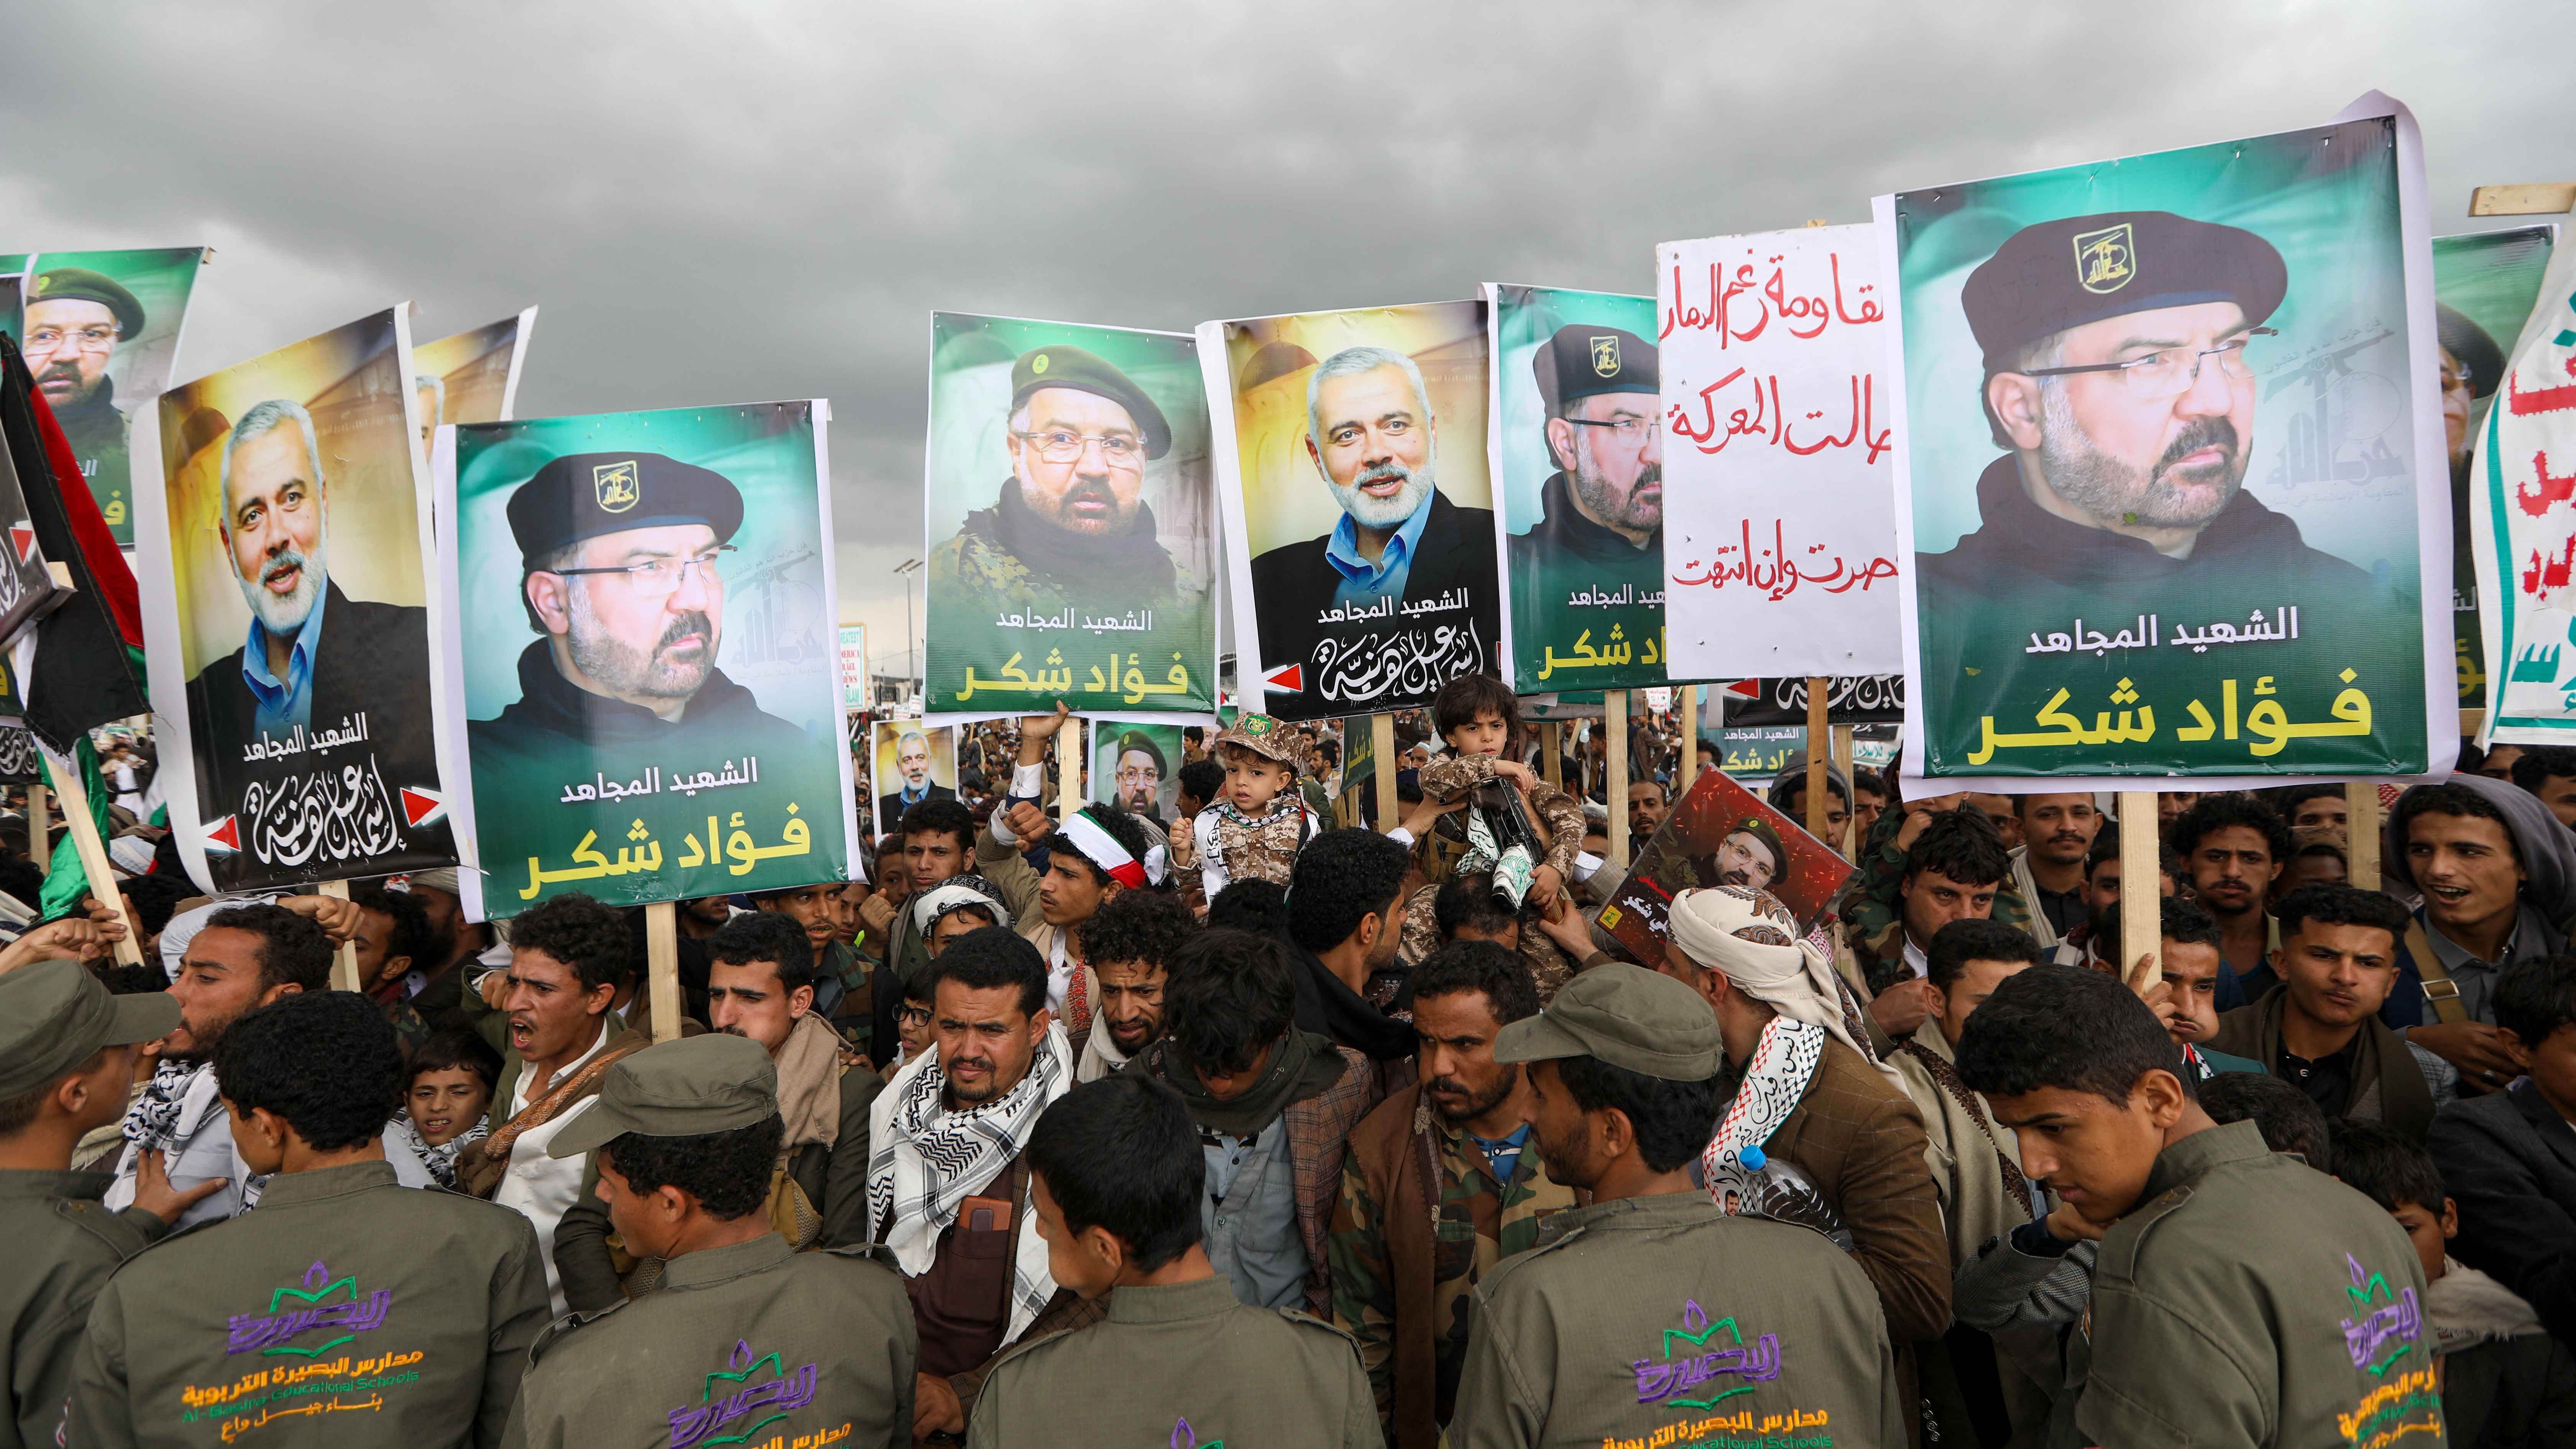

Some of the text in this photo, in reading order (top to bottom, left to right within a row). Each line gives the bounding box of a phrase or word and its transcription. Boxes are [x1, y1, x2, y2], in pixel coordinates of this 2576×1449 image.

[1765, 253, 1883, 338] قاومة
[1668, 368, 1781, 454] المعركة
[1798, 543, 1898, 593] صرت
[1318, 588, 1468, 623] الشهيد المجاهد
[1569, 584, 1665, 609] هيد المجاهد
[840, 631, 859, 644] REATEST
[996, 606, 1152, 635] الشهيد المجاهد
[2026, 606, 2298, 656] الشهيد المجاهد
[841, 650, 860, 658] MERICA
[842, 662, 855, 670] RAEL
[1539, 624, 1666, 679] اد شكر
[956, 647, 1189, 704] فؤاد شكر
[845, 688, 859, 703] SLAM
[2177, 669, 2372, 756] فؤاد
[243, 712, 368, 762] الشهيد المجاهد
[1724, 728, 1799, 741] الشهيد المجاهد
[1967, 678, 2155, 764] شكر
[1720, 748, 1794, 770] اد شك
[561, 756, 757, 803] الشهيد المجاهد
[520, 804, 810, 899] فؤاد شكر
[1622, 896, 1668, 933] لي شكر
[182, 1351, 423, 1408] مدارس البصيرة التربوية
[272, 1381, 353, 1400] Educational
[356, 1370, 419, 1390] Schools
[1678, 1411, 1753, 1441] البصيرة
[1758, 1408, 1829, 1434] مدارس
[1766, 1434, 1833, 1449] Schools
